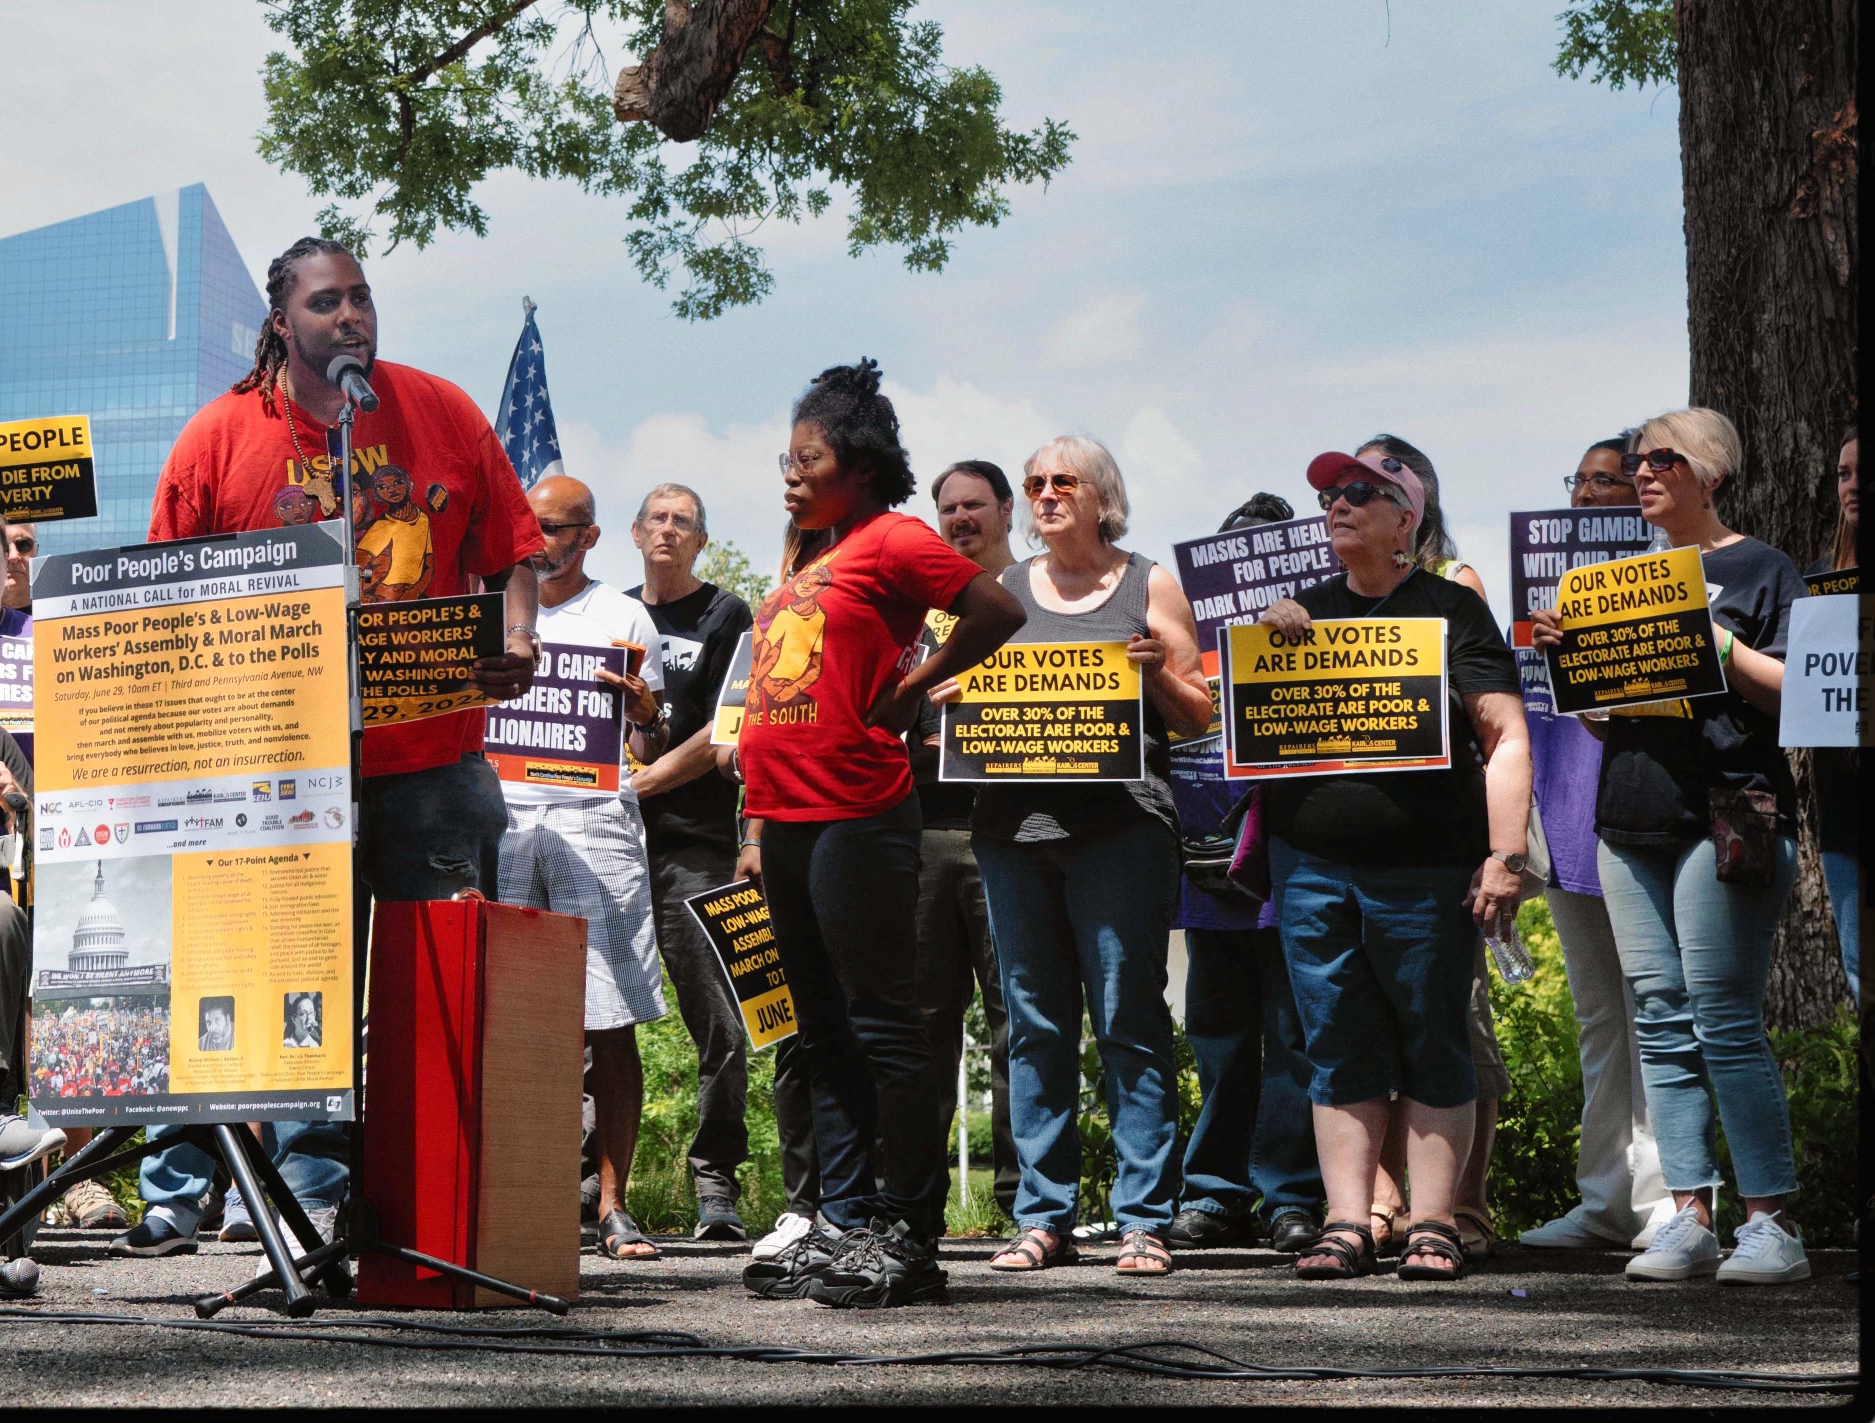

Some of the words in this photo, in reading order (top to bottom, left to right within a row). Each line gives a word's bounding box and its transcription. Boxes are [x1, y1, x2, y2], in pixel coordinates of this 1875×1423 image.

[2, 470, 27, 485] DIE
[31, 464, 80, 482] FROM
[1529, 518, 1572, 545] STOP
[72, 563, 112, 584] Poor
[200, 540, 297, 569] Campaign
[1190, 537, 1249, 568] MASKS
[1253, 530, 1285, 555] ARE
[1233, 559, 1266, 584] FOR
[1268, 547, 1330, 578] PEOPLE
[1523, 552, 1567, 578] WITH
[1570, 571, 1607, 594] OUR
[1611, 560, 1670, 586] VOTES
[71, 600, 77, 611] A
[82, 593, 139, 610] NATIONAL
[144, 588, 173, 602] CALL
[178, 587, 195, 598] for
[201, 581, 242, 596] MORAL
[248, 574, 300, 591] REVIVAL
[1193, 593, 1236, 622] DARK
[1238, 581, 1295, 611] MONEY
[1561, 597, 1593, 621] ARE
[1598, 582, 1688, 614] DEMANDS
[63, 626, 100, 641] Mass
[104, 621, 138, 636] Poor
[210, 610, 222, 624] &
[227, 602, 310, 622] Low-Wage
[469, 605, 482, 618] &
[124, 634, 198, 655] Assembly
[203, 632, 214, 647] &
[219, 625, 265, 645] Moral
[270, 620, 322, 640] March
[1269, 628, 1317, 649] OUR
[1324, 626, 1401, 645] VOTES
[1578, 631, 1609, 648] OVER
[1611, 627, 1637, 642] 30%
[1639, 623, 1657, 637] OF
[1657, 619, 1680, 635] THE
[57, 671, 74, 683] on
[78, 661, 174, 681] Washington,
[179, 654, 208, 670] D.C.
[212, 652, 224, 667] &
[228, 652, 245, 665] to
[250, 648, 276, 663] the
[281, 642, 319, 660] Polls
[380, 651, 416, 664] AND
[420, 646, 478, 662] MORAL
[981, 650, 1027, 669] OUR
[1033, 649, 1103, 668] VOTES
[1254, 653, 1296, 673] ARE
[1305, 649, 1419, 670] DEMANDS
[1559, 645, 1631, 668] ELECTORATE
[1633, 641, 1656, 656] ARE
[1657, 636, 1692, 653] POOR
[1695, 634, 1706, 648] &
[558, 653, 606, 682] CARE
[1569, 663, 1637, 684] LOW-WAGE
[1637, 653, 1699, 674] WORKERS
[55, 690, 90, 701] Saturday,
[92, 688, 110, 700] June
[113, 686, 124, 696] 29,
[128, 685, 149, 694] 10am
[152, 682, 162, 692] ET
[171, 679, 192, 690] Third
[195, 677, 210, 687] and
[213, 672, 268, 685] Pennsylvania
[271, 669, 304, 680] Avenue,
[307, 666, 323, 676] NW
[388, 685, 438, 696] POLLS
[967, 675, 1006, 693] ARE
[1015, 672, 1120, 692] DEMANDS
[1271, 686, 1310, 701] OVER
[1314, 685, 1346, 698] 30%
[1350, 684, 1370, 697] OF
[1373, 683, 1401, 696] THE
[578, 690, 613, 719] FOR
[748, 712, 763, 726] THE
[769, 702, 818, 726] SOUTH
[981, 707, 1020, 720] OVER
[1023, 707, 1053, 720] 30%
[1057, 706, 1076, 719] OF
[1079, 706, 1104, 719] THE
[1246, 702, 1334, 720] ELECTORATE
[1337, 701, 1365, 715] ARE
[1370, 699, 1413, 713] POOR
[1417, 698, 1430, 712] &
[956, 724, 1042, 738] ELECTORATE
[1044, 723, 1071, 737] ARE
[1075, 723, 1115, 736] POOR
[1118, 723, 1130, 736] &
[1254, 719, 1338, 736] LOW-WAGE
[1341, 716, 1418, 732] WORKERS
[962, 741, 1045, 754] LOW-WAGE
[1048, 740, 1119, 753] WORKERS
[72, 768, 88, 780] We
[92, 768, 108, 778] are
[112, 767, 118, 776] a
[121, 760, 190, 775] resurrection,
[194, 757, 212, 769] not
[216, 757, 230, 767] an
[233, 750, 305, 766] insurrection.
[69, 800, 103, 808] AFL-CIO
[218, 858, 233, 867] Our
[235, 855, 266, 866] 17-Point
[268, 854, 298, 865] Agenda
[704, 896, 735, 917] MASS
[733, 888, 763, 908] POOR
[730, 955, 764, 978] MARCH
[765, 947, 779, 965] ON
[766, 971, 779, 987] TO
[756, 998, 793, 1034] JUNE
[61, 1107, 105, 1116] @UniteThePoor
[210, 1103, 236, 1111] Website:
[238, 1101, 320, 1110] poorpeoplescampaign.org
